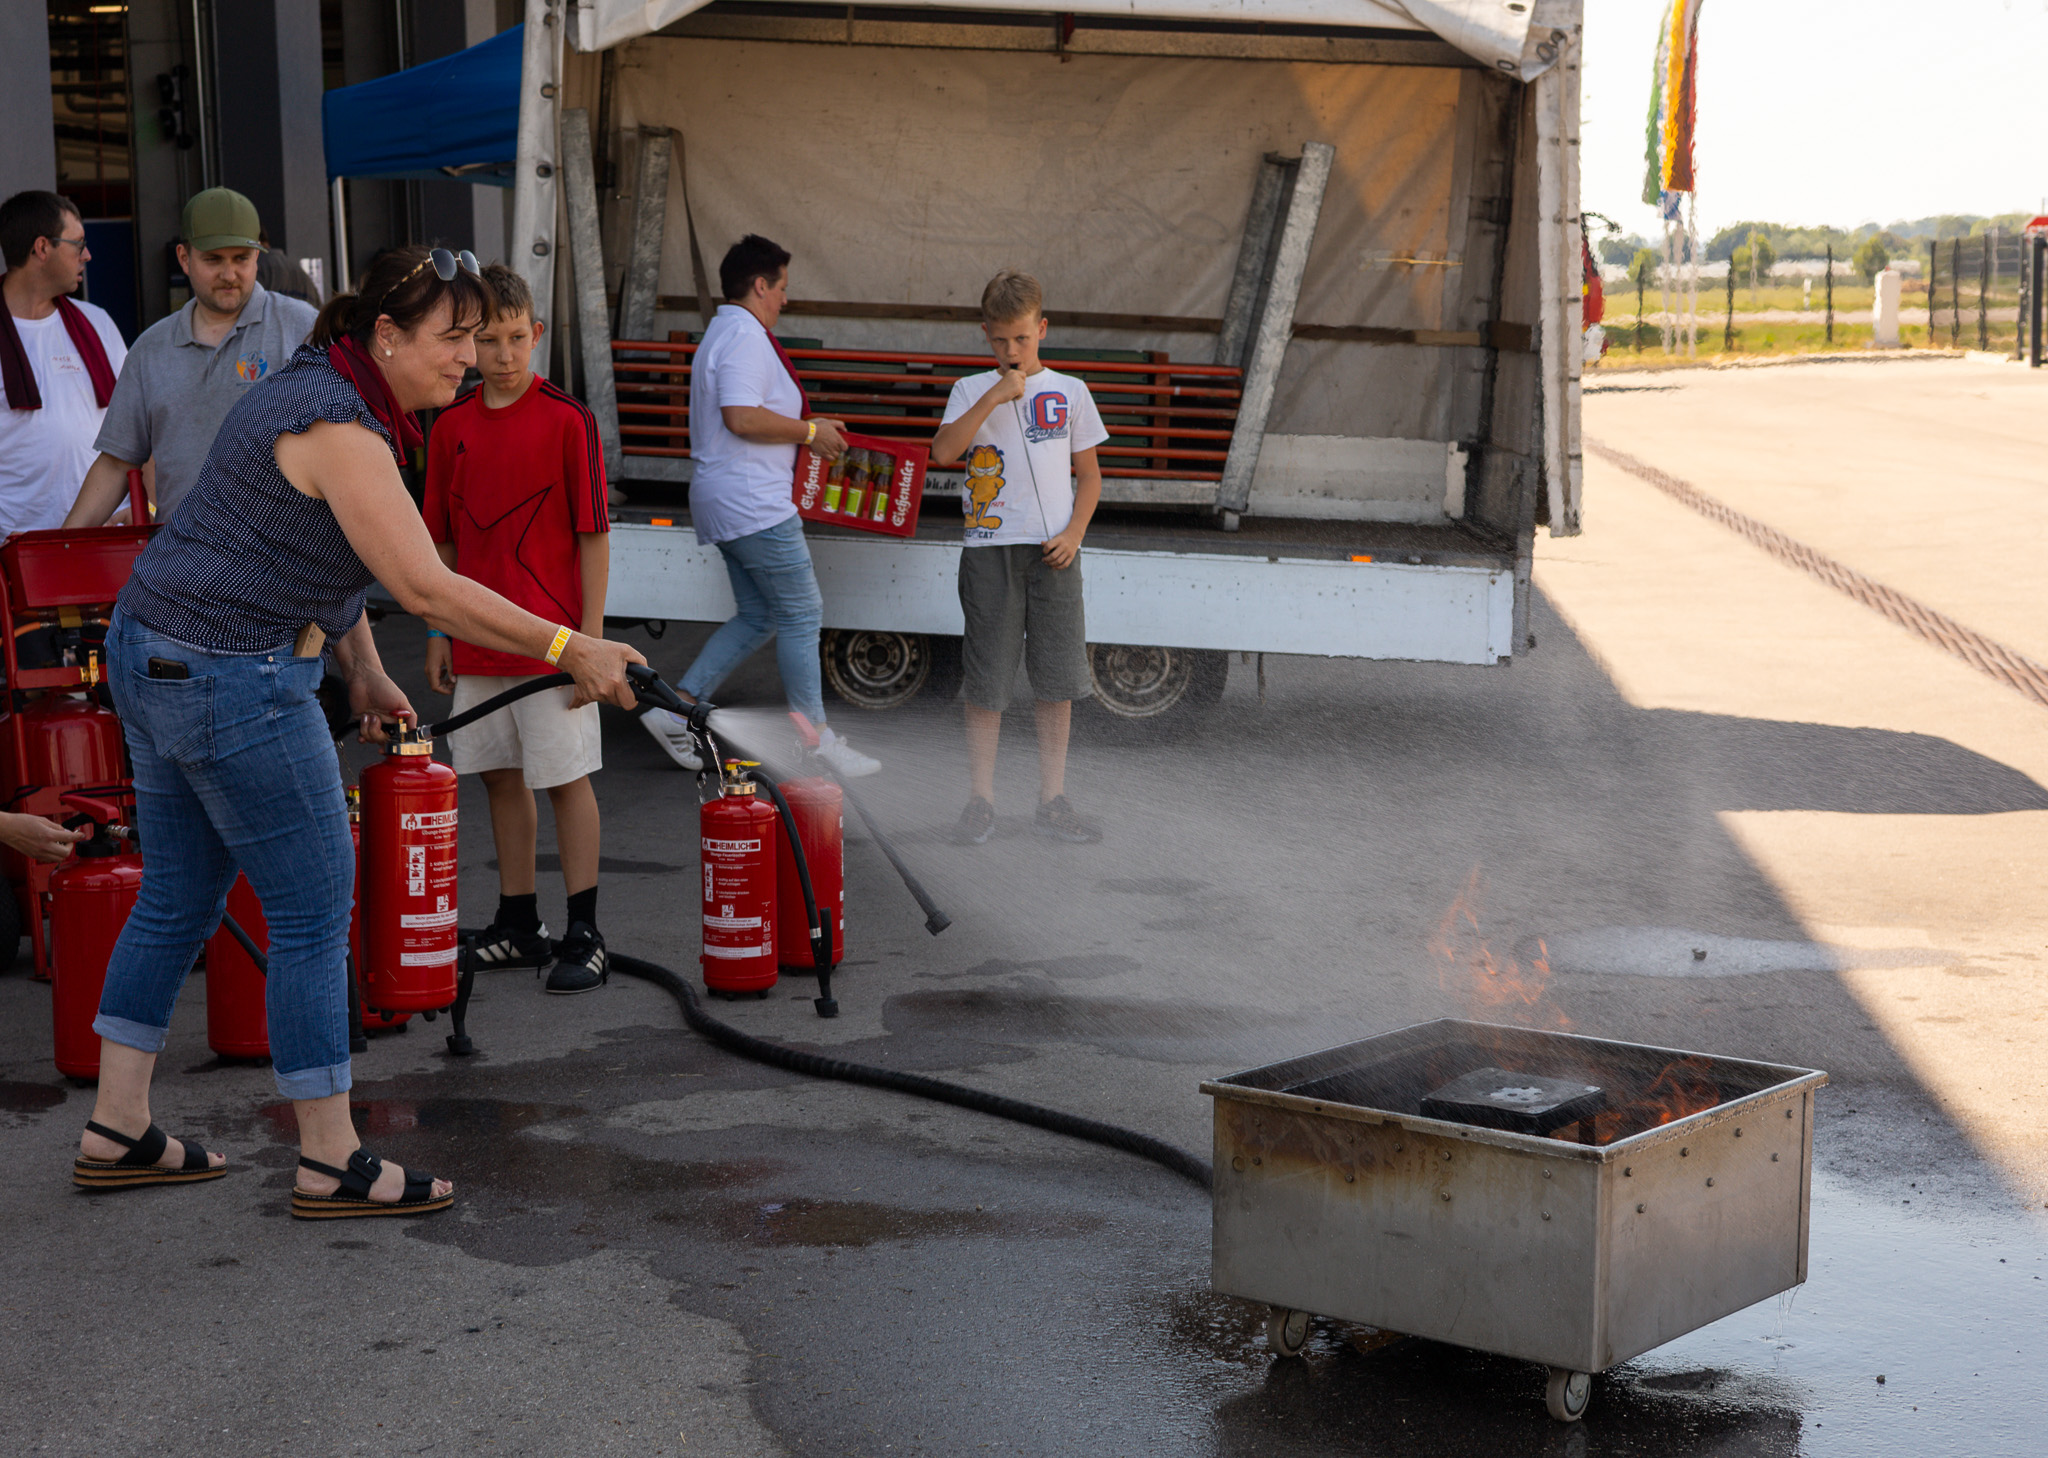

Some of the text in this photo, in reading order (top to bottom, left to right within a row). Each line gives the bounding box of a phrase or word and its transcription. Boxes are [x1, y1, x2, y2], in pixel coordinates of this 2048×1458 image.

[1031, 391, 1068, 430] G
[891, 459, 915, 527] Eichentaler
[978, 531, 994, 539] CAT
[716, 842, 751, 850] HEIMLICH
